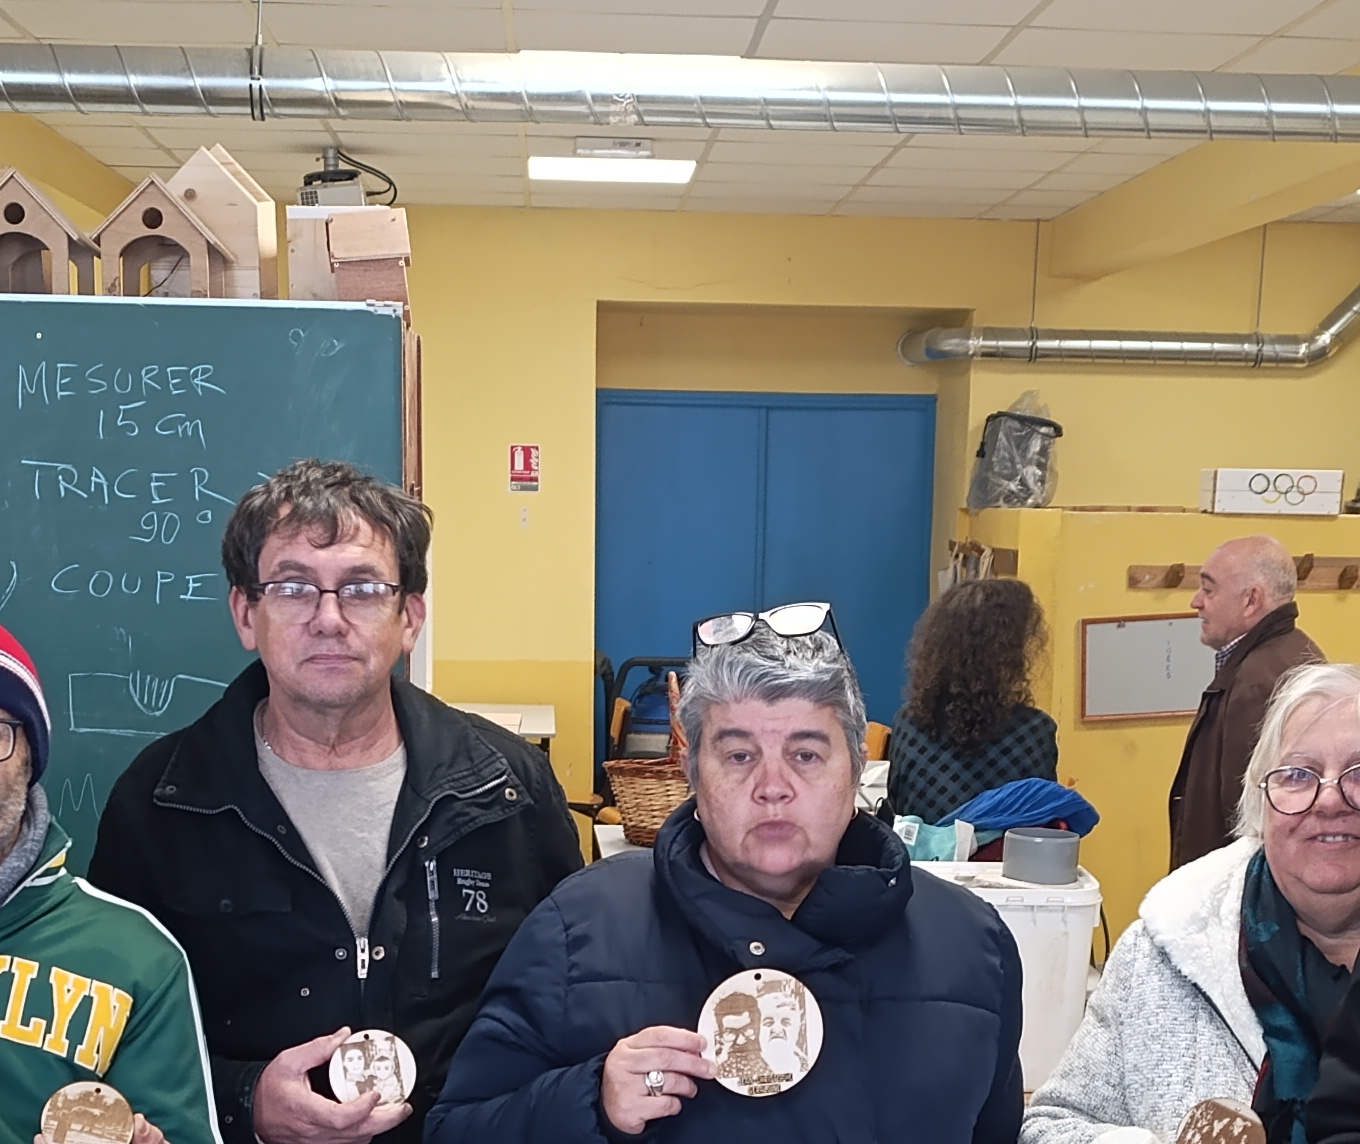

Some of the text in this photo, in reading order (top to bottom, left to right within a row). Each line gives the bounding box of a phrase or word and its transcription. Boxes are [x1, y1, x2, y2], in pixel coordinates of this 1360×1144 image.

[18, 361, 227, 409] MESURER
[99, 400, 147, 439] 15
[21, 460, 237, 505] TRACER
[453, 868, 492, 880] HERITAGE
[462, 888, 489, 913] 78
